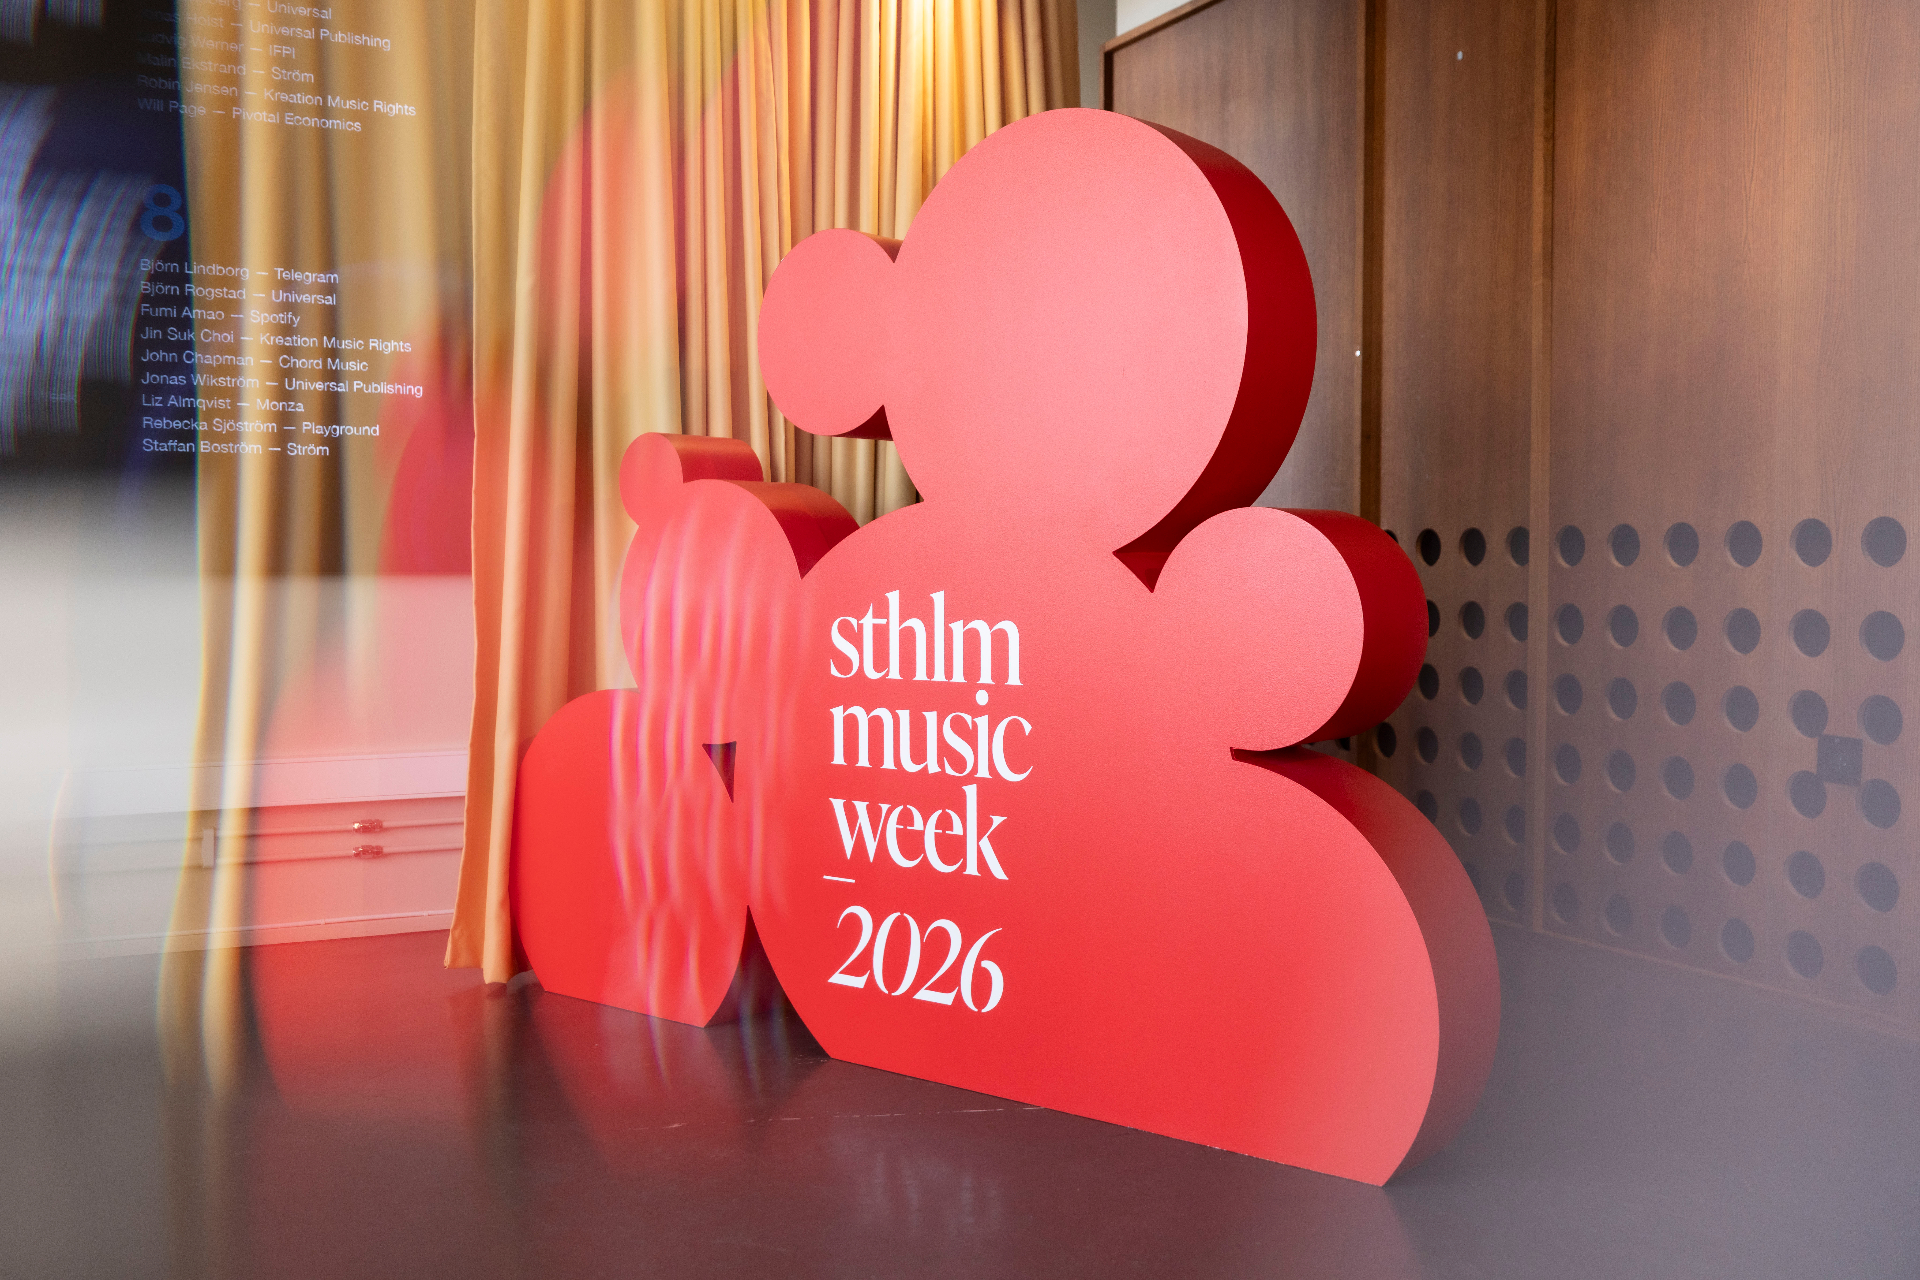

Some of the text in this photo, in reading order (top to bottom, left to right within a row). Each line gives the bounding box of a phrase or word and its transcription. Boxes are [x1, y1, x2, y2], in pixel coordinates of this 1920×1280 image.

[267, 1, 332, 20] Universal
[185, 14, 224, 28] Holst
[250, 20, 315, 40] Universal
[320, 29, 391, 51] Publishing
[191, 35, 244, 53] Werner
[269, 44, 295, 59] IFPI
[182, 56, 246, 76] Ekstrand
[271, 66, 314, 83] Ström
[138, 74, 180, 91] Robin
[186, 80, 238, 97] Jensen
[264, 88, 322, 107] Kreation
[327, 94, 369, 112] Music
[373, 100, 417, 117] Rights
[138, 98, 163, 112] Will
[169, 101, 206, 118] Page
[232, 106, 280, 124] Pivotal
[284, 113, 362, 132] Economics
[140, 184, 185, 241] 8
[140, 258, 179, 275] Björn
[184, 262, 249, 280] Lindborg
[274, 267, 339, 284] Telegram
[140, 281, 180, 297] Björn
[185, 284, 245, 300] Rogstad
[271, 289, 336, 306] Universal
[141, 304, 177, 318] Fumi
[181, 306, 224, 321] Amao
[250, 310, 300, 327] Spotify
[140, 327, 162, 340] Jin
[167, 328, 195, 341] Suk
[200, 329, 234, 343] Choi
[260, 333, 318, 348] Kreation
[323, 336, 364, 351] Music
[369, 338, 412, 354] Rights
[141, 349, 178, 363] John
[184, 351, 254, 367] Chapman
[279, 355, 322, 370] Chord
[327, 358, 369, 372] Music
[141, 372, 187, 386] Jonas
[191, 374, 259, 389] Wikström
[285, 378, 349, 393] Universal
[353, 382, 423, 398] Publishing
[142, 394, 162, 407] Liz
[167, 395, 231, 411] Almqvist
[256, 398, 304, 412] Monza
[143, 417, 208, 431] Rebecka
[213, 418, 277, 435] Sjöström
[302, 422, 380, 438] Playground
[143, 439, 195, 453] Staffan
[200, 440, 262, 455] Boström
[287, 443, 329, 457] Ström
[830, 589, 1023, 686] sthlm
[830, 689, 1033, 783] music
[829, 784, 1009, 880] week
[827, 905, 1004, 1013] 2026
